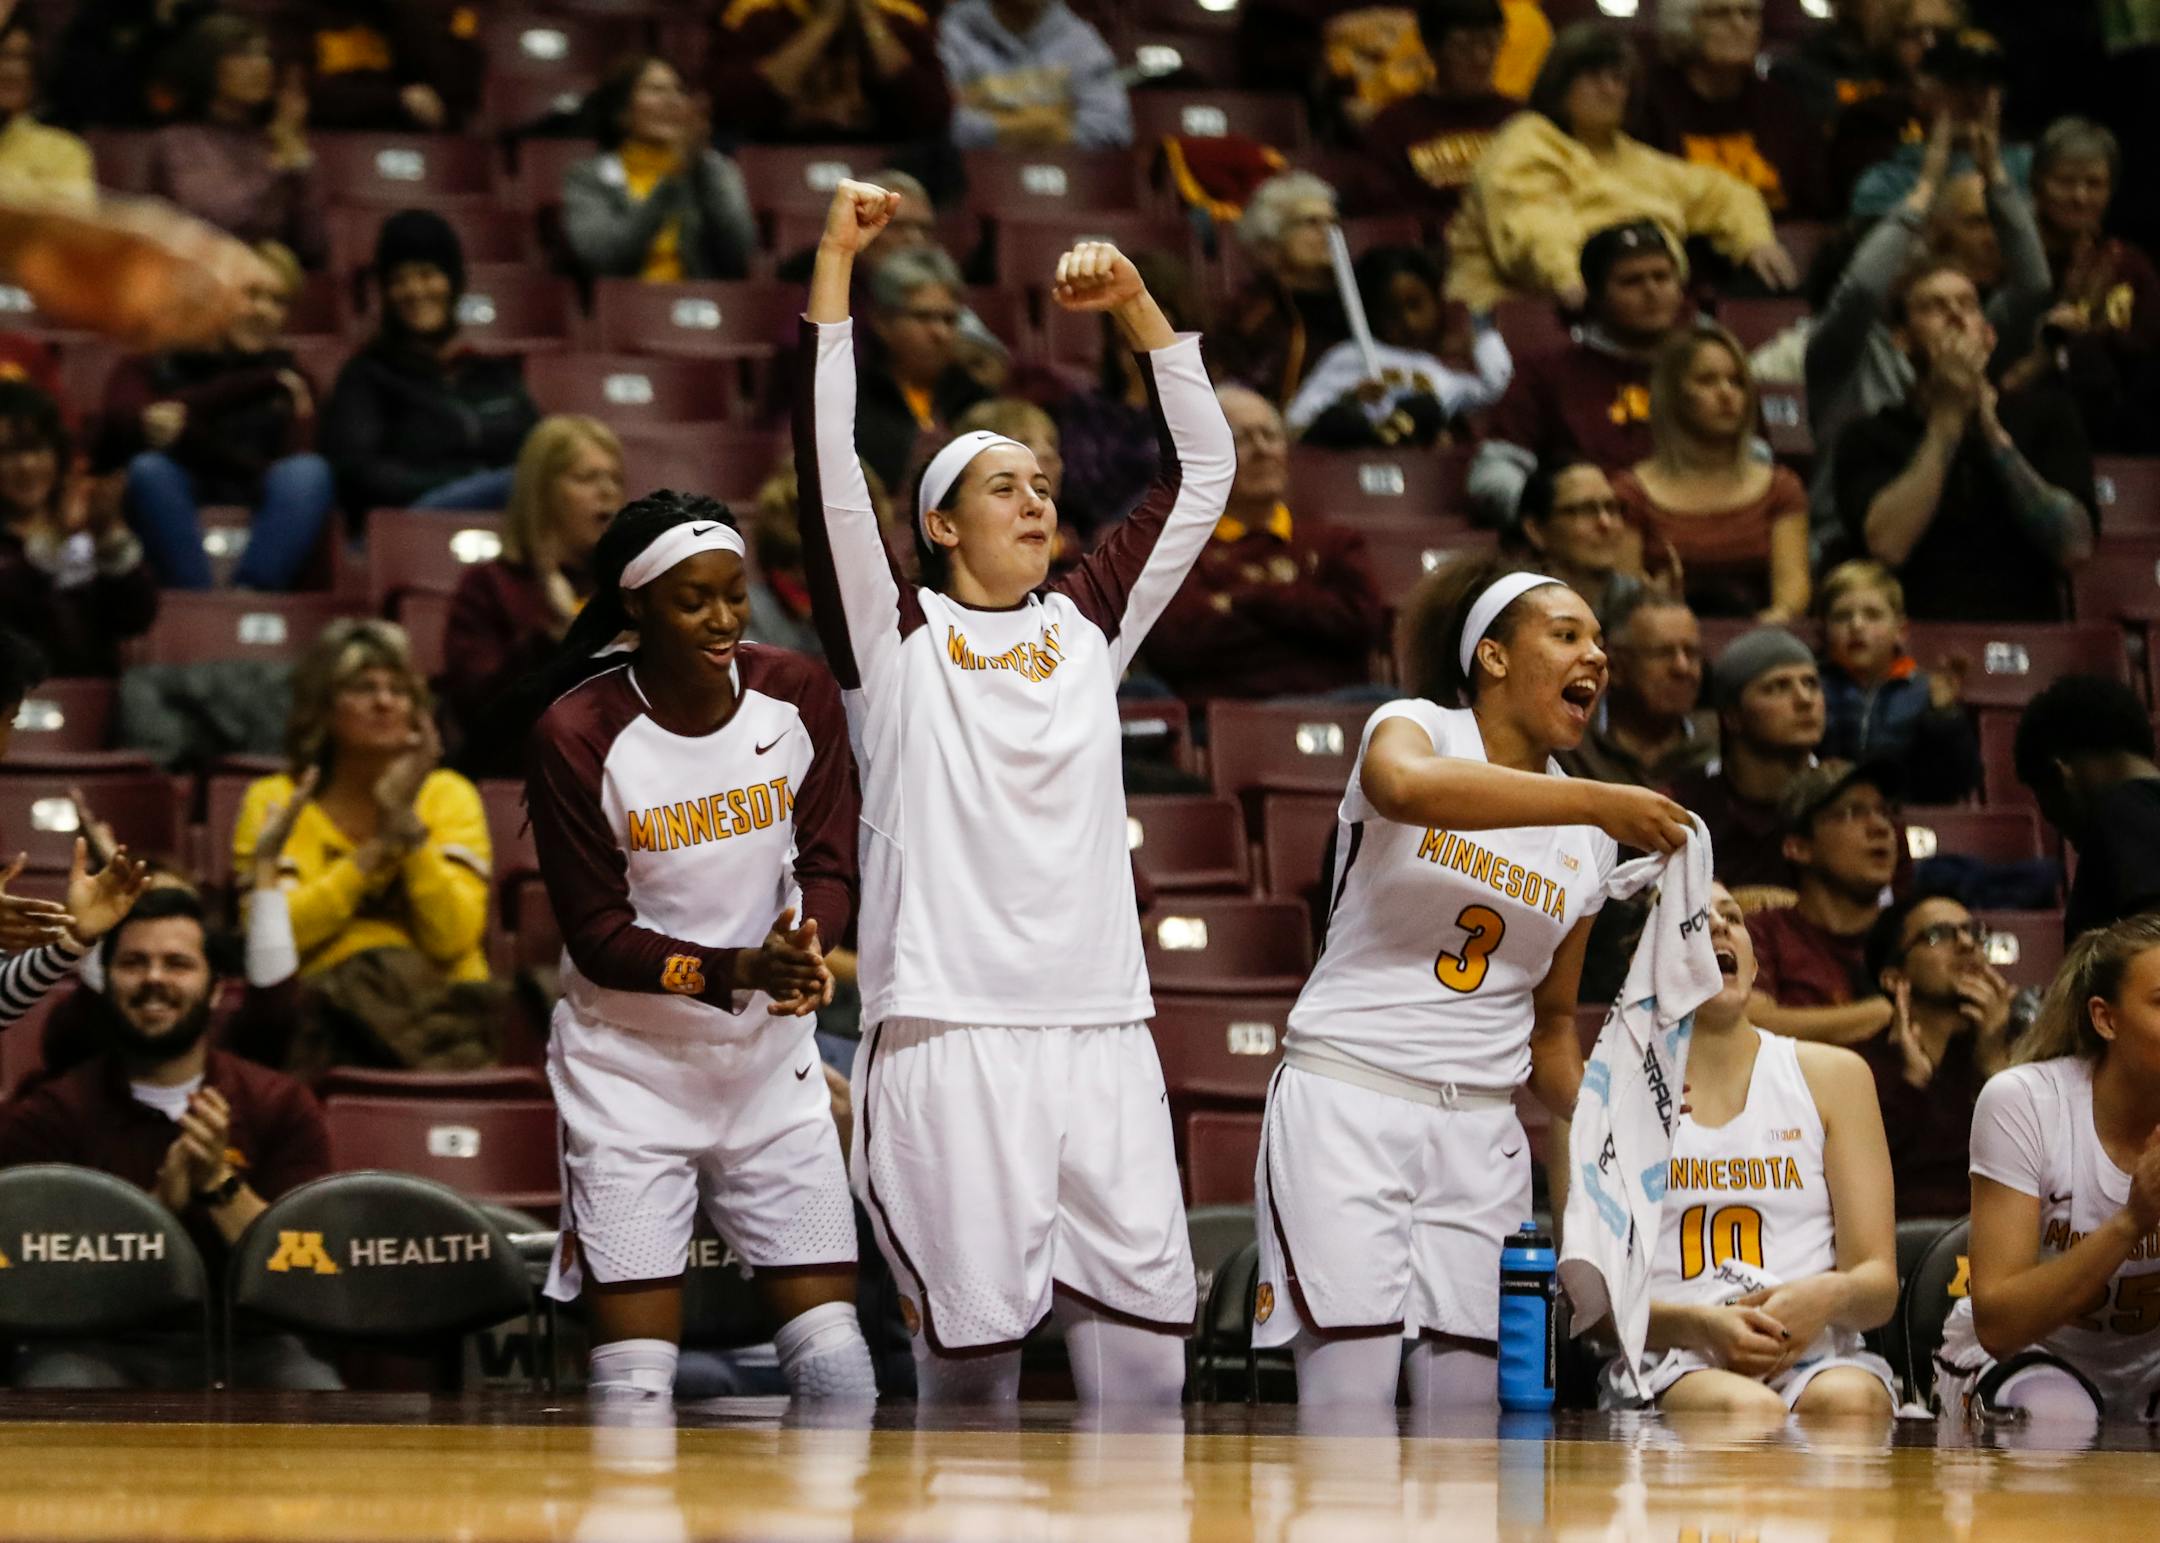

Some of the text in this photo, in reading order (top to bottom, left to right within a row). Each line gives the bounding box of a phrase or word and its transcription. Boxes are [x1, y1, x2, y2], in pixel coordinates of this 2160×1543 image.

[1417, 825, 1567, 924] MINNESOTA
[1434, 904, 1506, 993] 3
[1665, 1156, 1804, 1190] NNESOTA
[21, 1232, 165, 1263] HEALTH
[350, 1232, 492, 1267] HEALTH
[1680, 1204, 1764, 1281] 10
